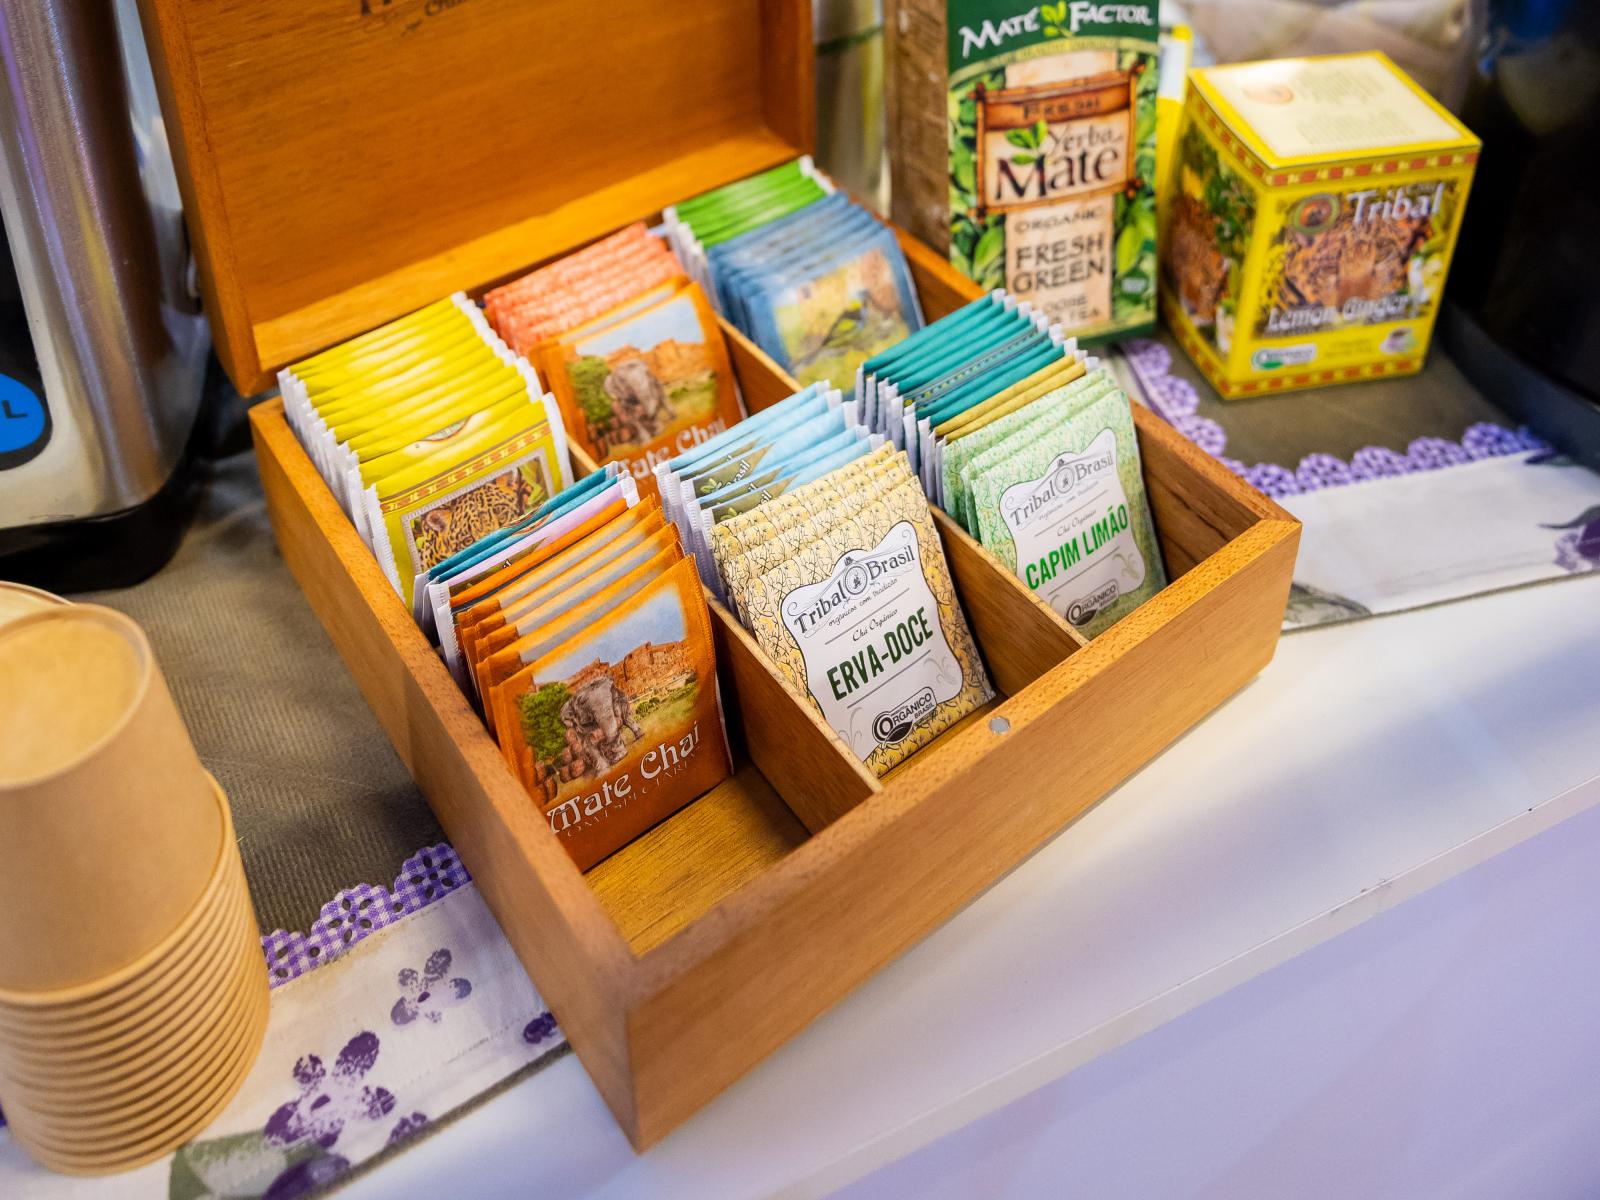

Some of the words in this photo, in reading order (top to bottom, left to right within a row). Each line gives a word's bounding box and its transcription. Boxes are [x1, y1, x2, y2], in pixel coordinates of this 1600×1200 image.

[1068, 0, 1153, 33] FACTOR
[1346, 181, 1445, 225] Tribal
[1015, 232, 1105, 269] FRESH
[1012, 257, 1105, 294] GREEN
[1042, 295, 1088, 314] OOSE
[1268, 305, 1338, 331] Lemon
[1010, 480, 1055, 526] Tribal
[1074, 450, 1114, 481] Brasil
[1025, 537, 1081, 590] CAPIM
[1081, 504, 1128, 556] LIMÃO
[794, 580, 848, 633] Tribal
[866, 545, 915, 580] Brasil
[827, 606, 934, 701] ERVA-DOCE
[914, 702, 934, 719] BRASIL
[547, 772, 632, 833] Mate
[640, 720, 700, 779] Chai
